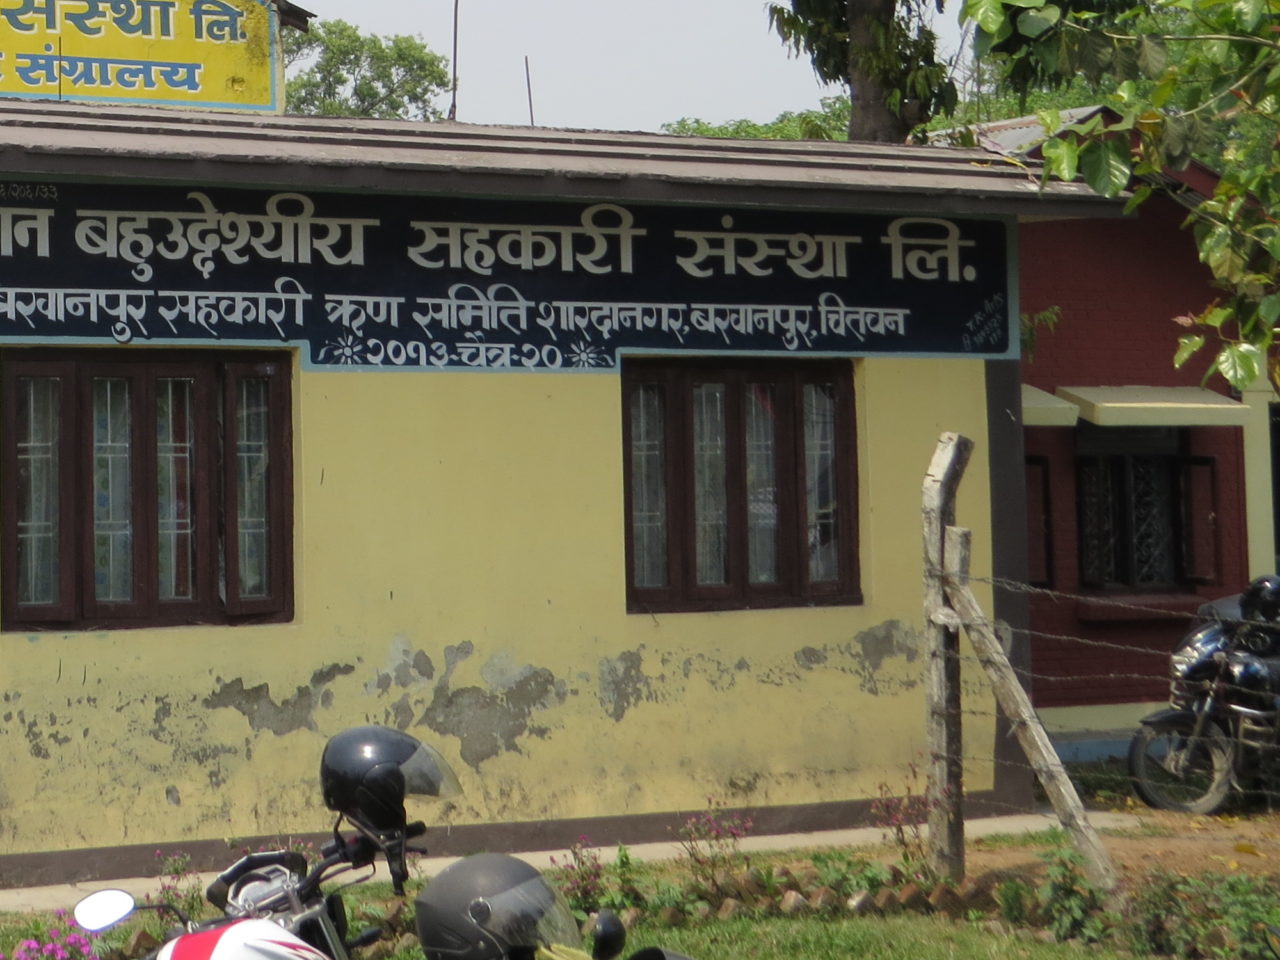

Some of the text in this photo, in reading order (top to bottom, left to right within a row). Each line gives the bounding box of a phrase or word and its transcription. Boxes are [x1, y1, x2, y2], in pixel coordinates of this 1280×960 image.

[15, 44, 203, 91] संग्रालय
[407, 203, 647, 276] सहकारी
[674, 214, 862, 279] संस्था
[880, 217, 977, 282] लि.
[158, 276, 312, 336] सहकारी
[324, 293, 405, 336] ऋण
[412, 283, 535, 339] समिति
[818, 292, 911, 342] चितवन
